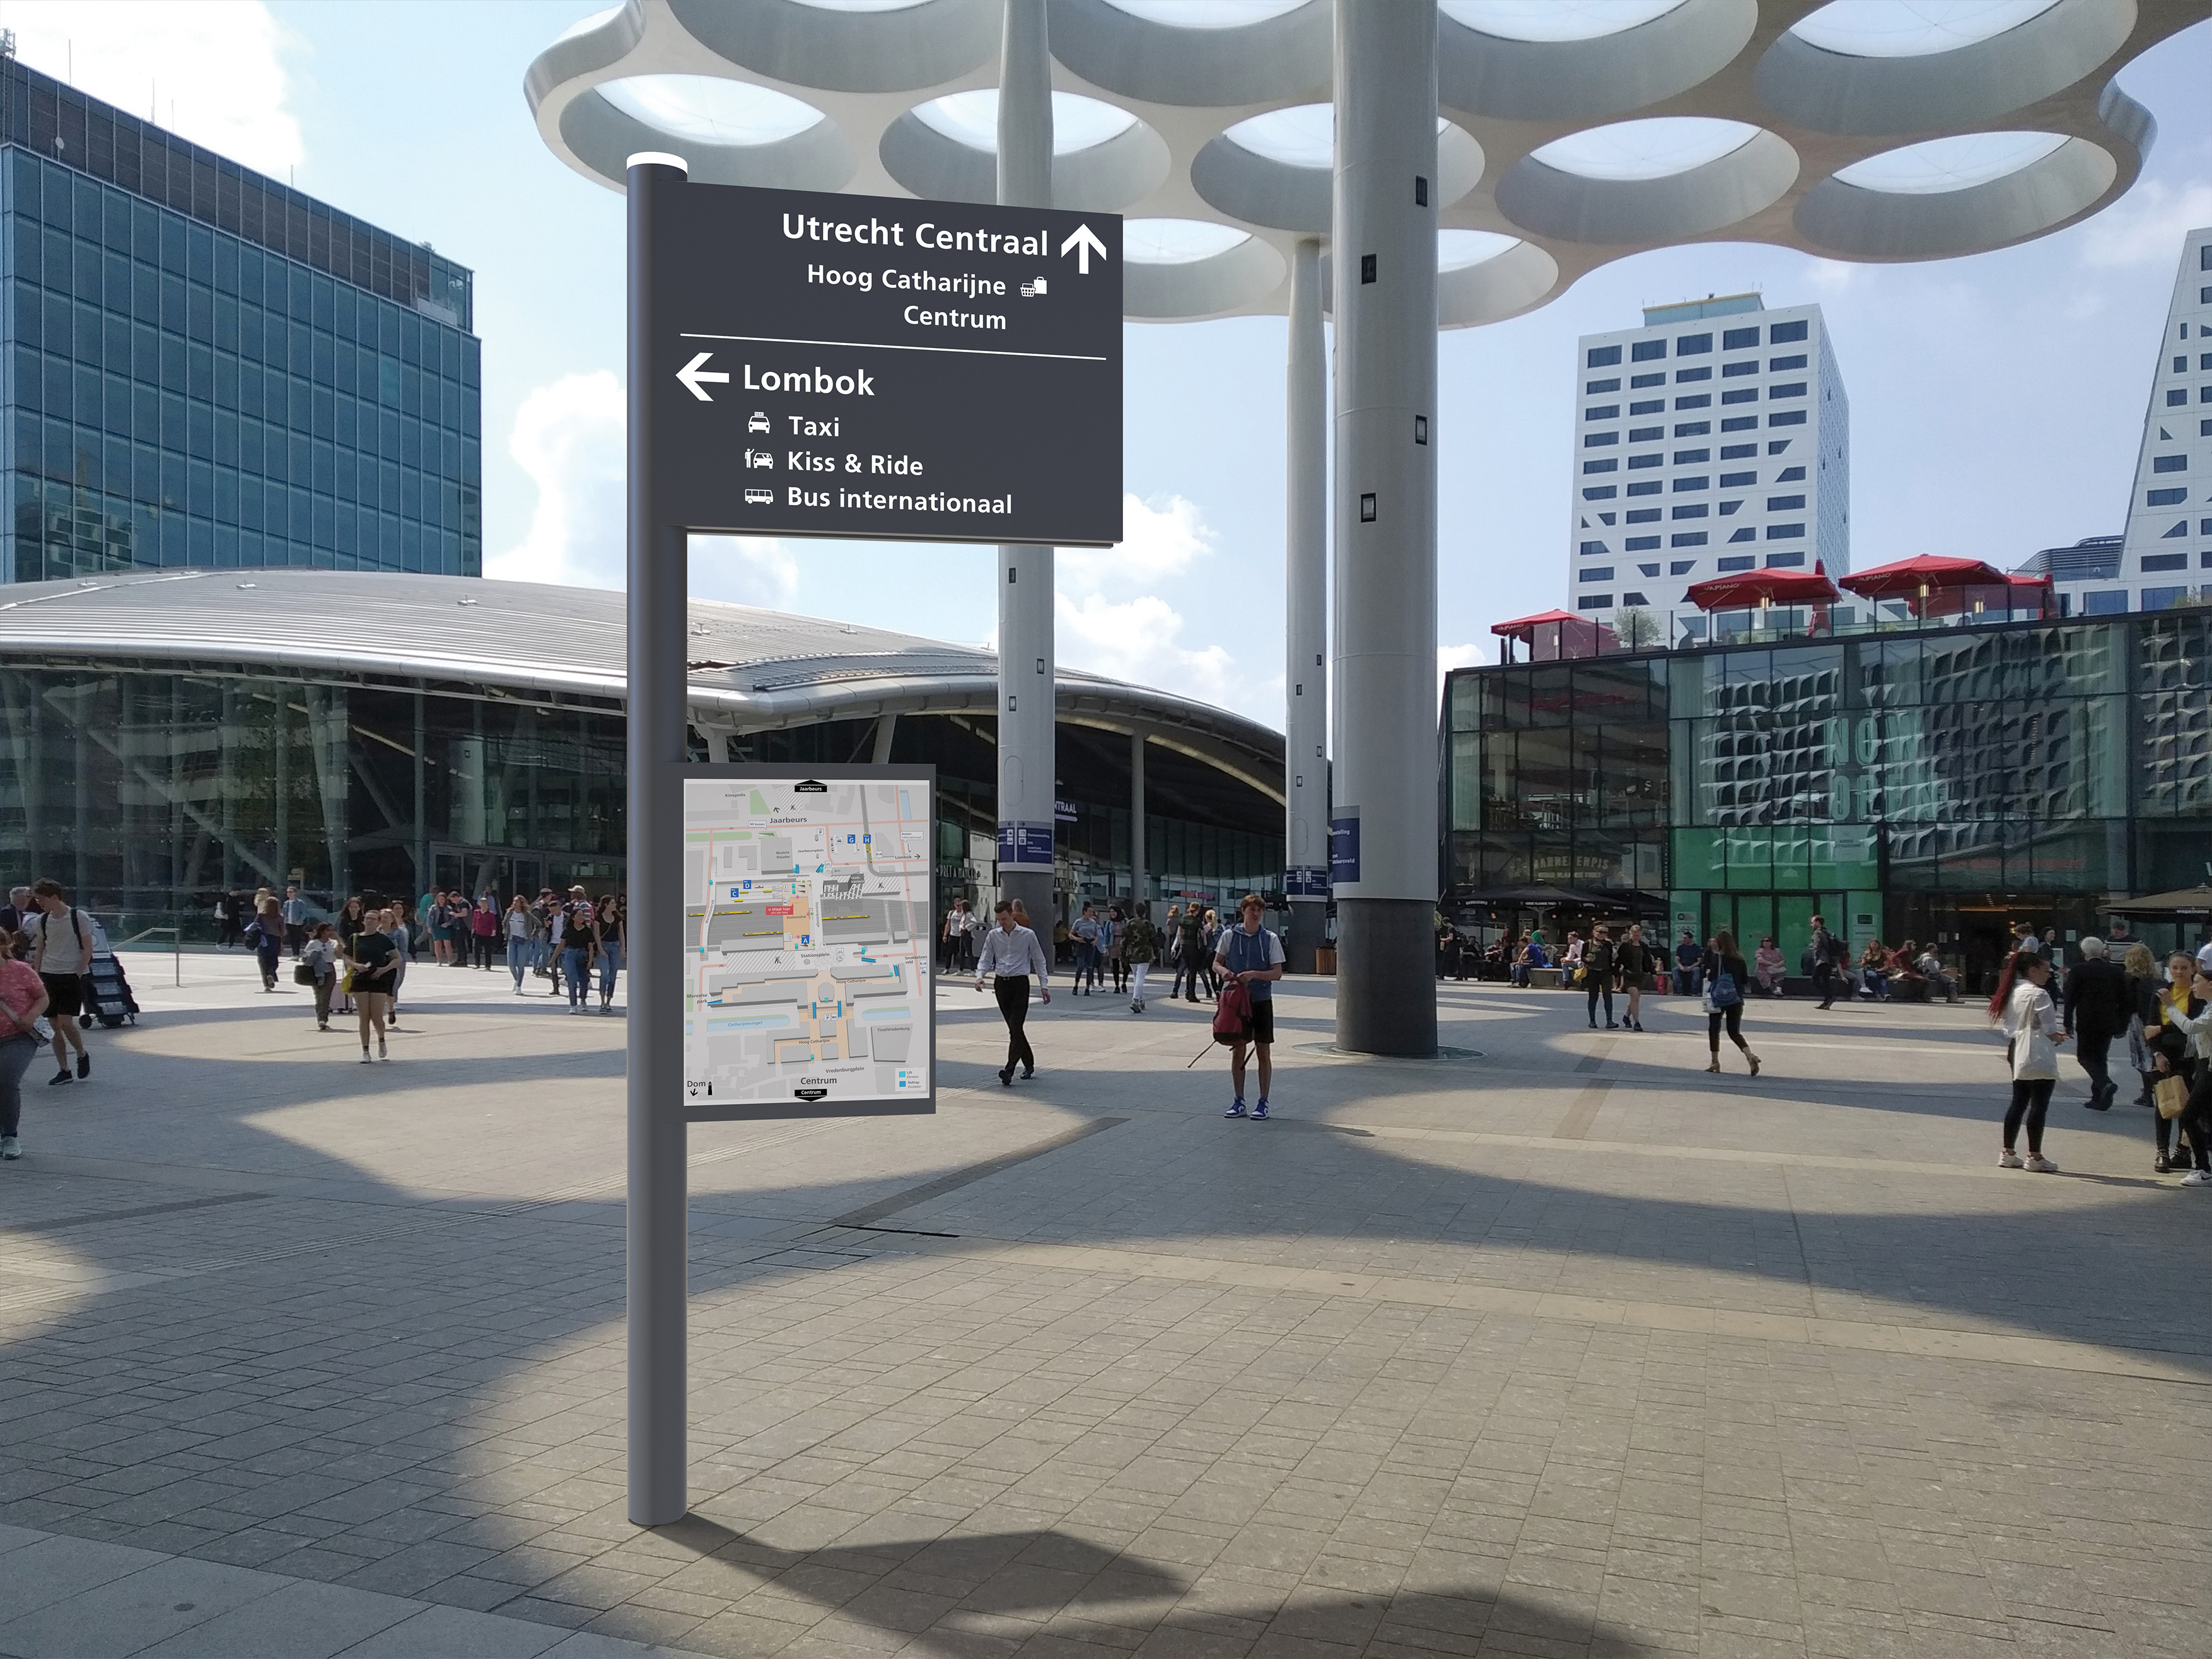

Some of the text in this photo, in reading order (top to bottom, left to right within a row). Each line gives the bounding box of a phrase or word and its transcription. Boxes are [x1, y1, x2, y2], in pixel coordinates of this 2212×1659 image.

[784, 214, 1047, 256] Utrecht Centraal
[808, 264, 1006, 299] Hoog Catharijne
[904, 306, 1006, 330] Centrum
[745, 364, 875, 396] Lombok
[789, 416, 839, 437] Taxi
[789, 451, 923, 476] Kiss & Ride
[789, 487, 1011, 514] Bus internationaal
[1824, 715, 1924, 766] NOW
[705, 900, 714, 924] Moreelsebrug
